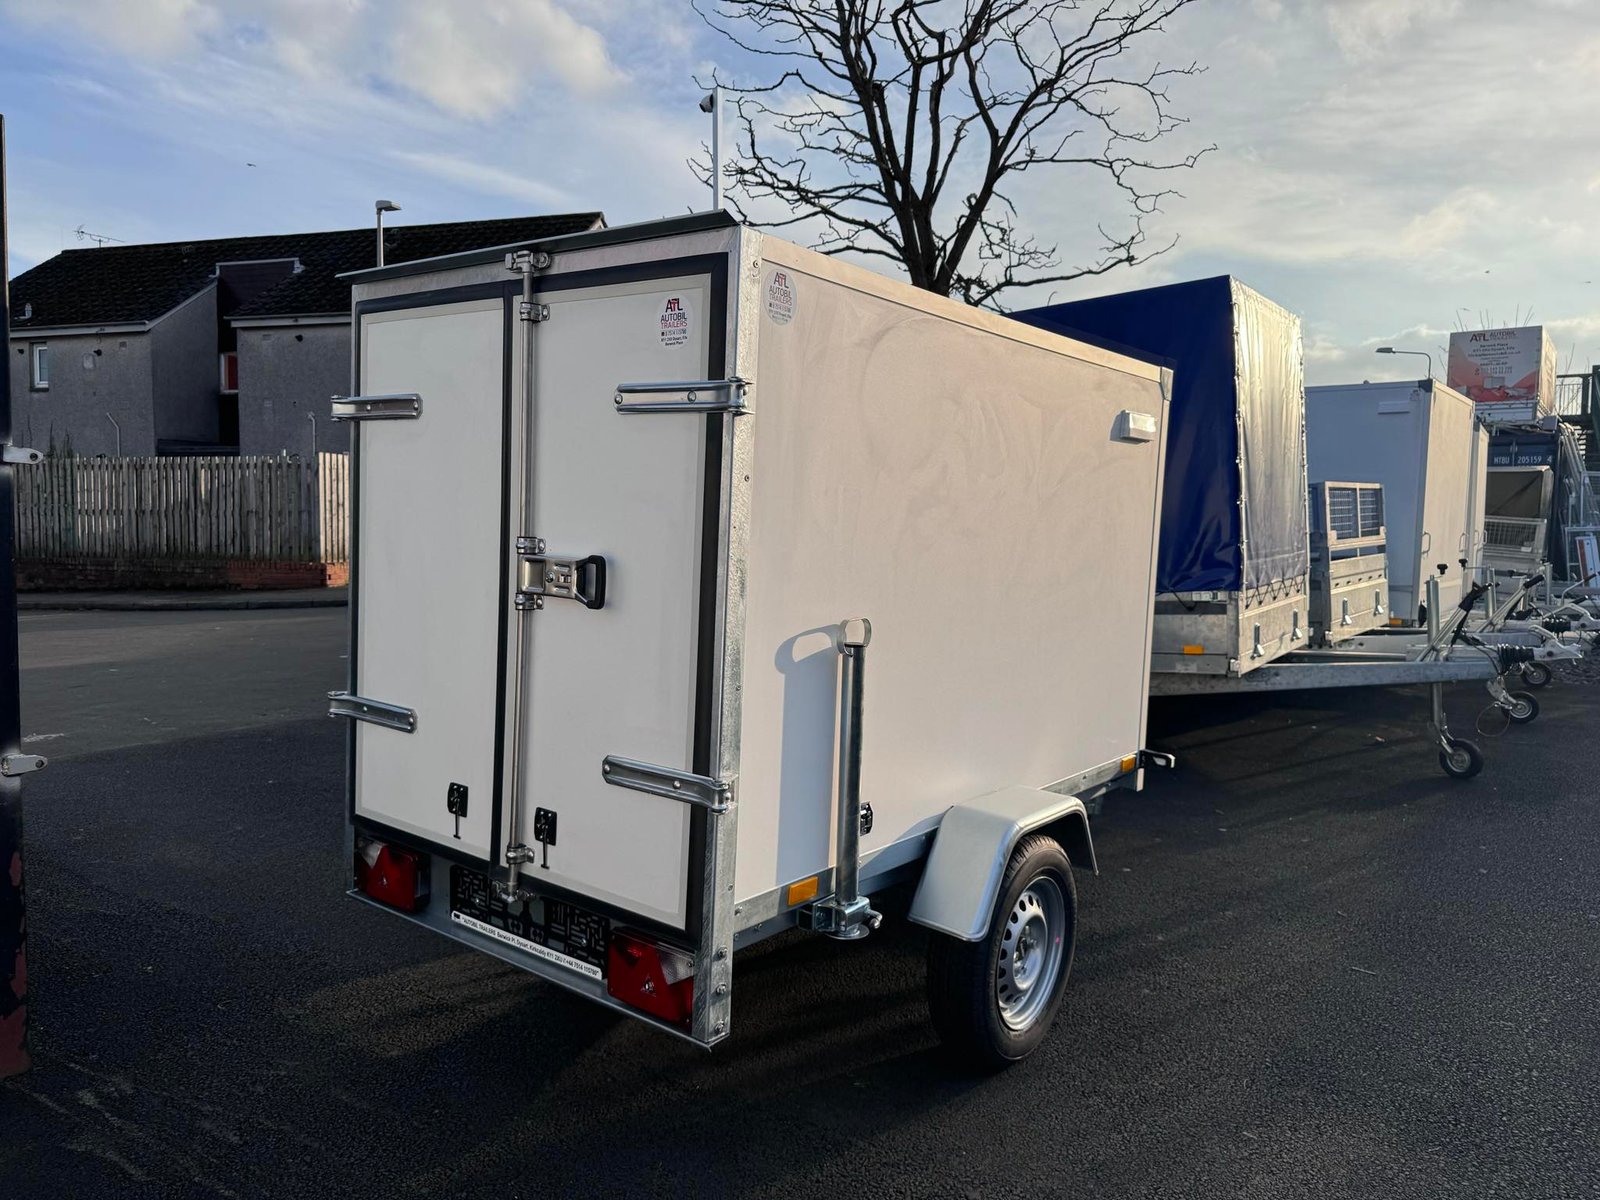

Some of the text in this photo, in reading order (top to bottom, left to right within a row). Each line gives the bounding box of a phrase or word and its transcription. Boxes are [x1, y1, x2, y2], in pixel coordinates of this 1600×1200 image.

[773, 272, 789, 289] ATL
[665, 298, 683, 313] ATL
[661, 312, 687, 323] AUTOBIL
[661, 319, 688, 329] TRAILERS
[1469, 333, 1489, 342] ATL
[1517, 455, 1542, 464] 205159
